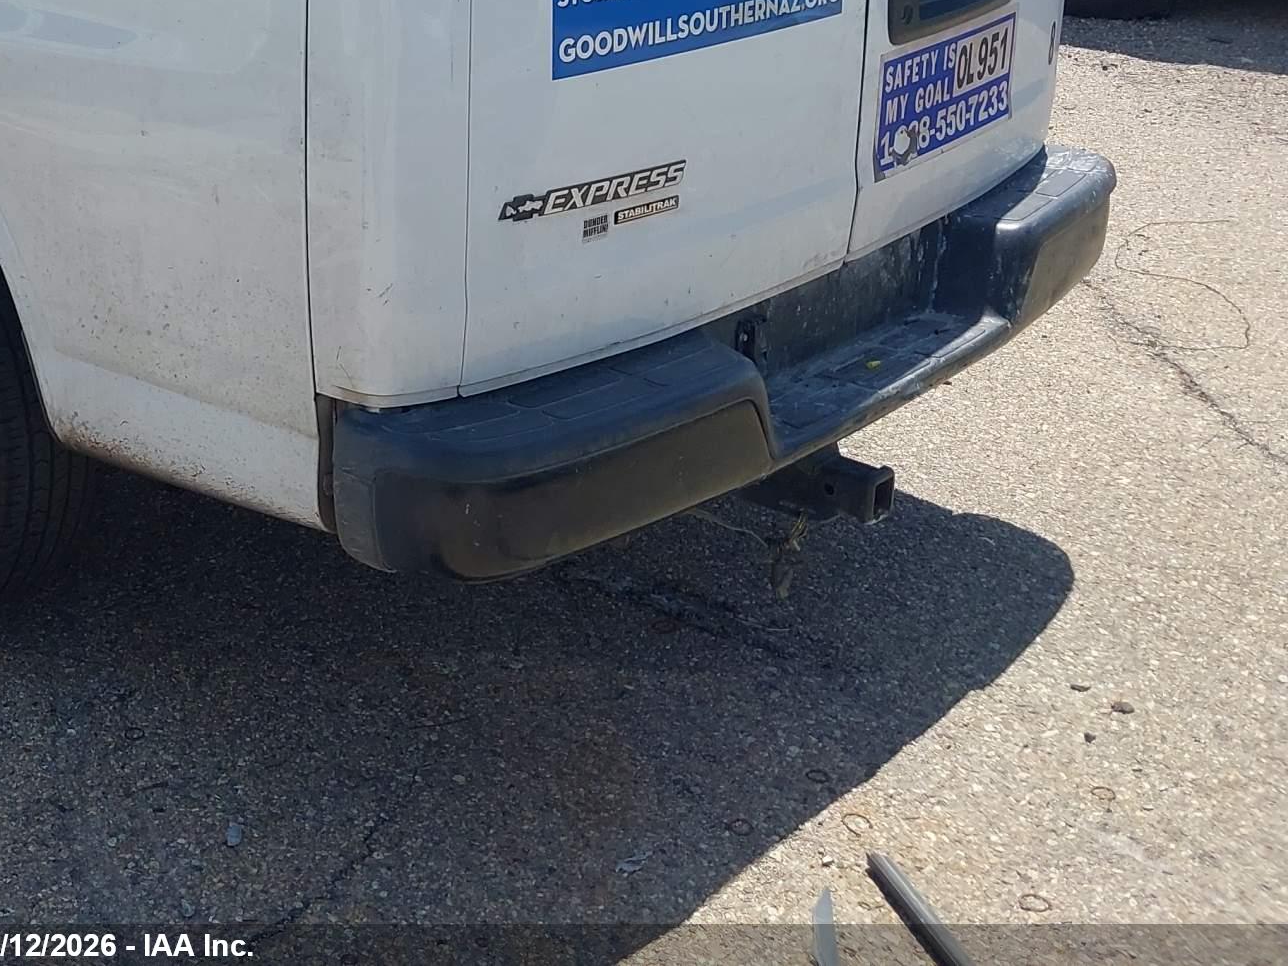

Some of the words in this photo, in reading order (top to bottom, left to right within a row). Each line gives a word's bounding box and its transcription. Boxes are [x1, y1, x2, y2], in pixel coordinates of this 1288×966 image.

[885, 49, 939, 93] SAFETY
[943, 42, 956, 71] IS
[880, 80, 1008, 166] 1-8-550-7233
[885, 93, 909, 126] MY
[915, 76, 951, 113] GOAL
[544, 163, 685, 215] EXPRESS
[617, 197, 677, 220] STABILITRAK
[583, 215, 608, 229] DUNDER
